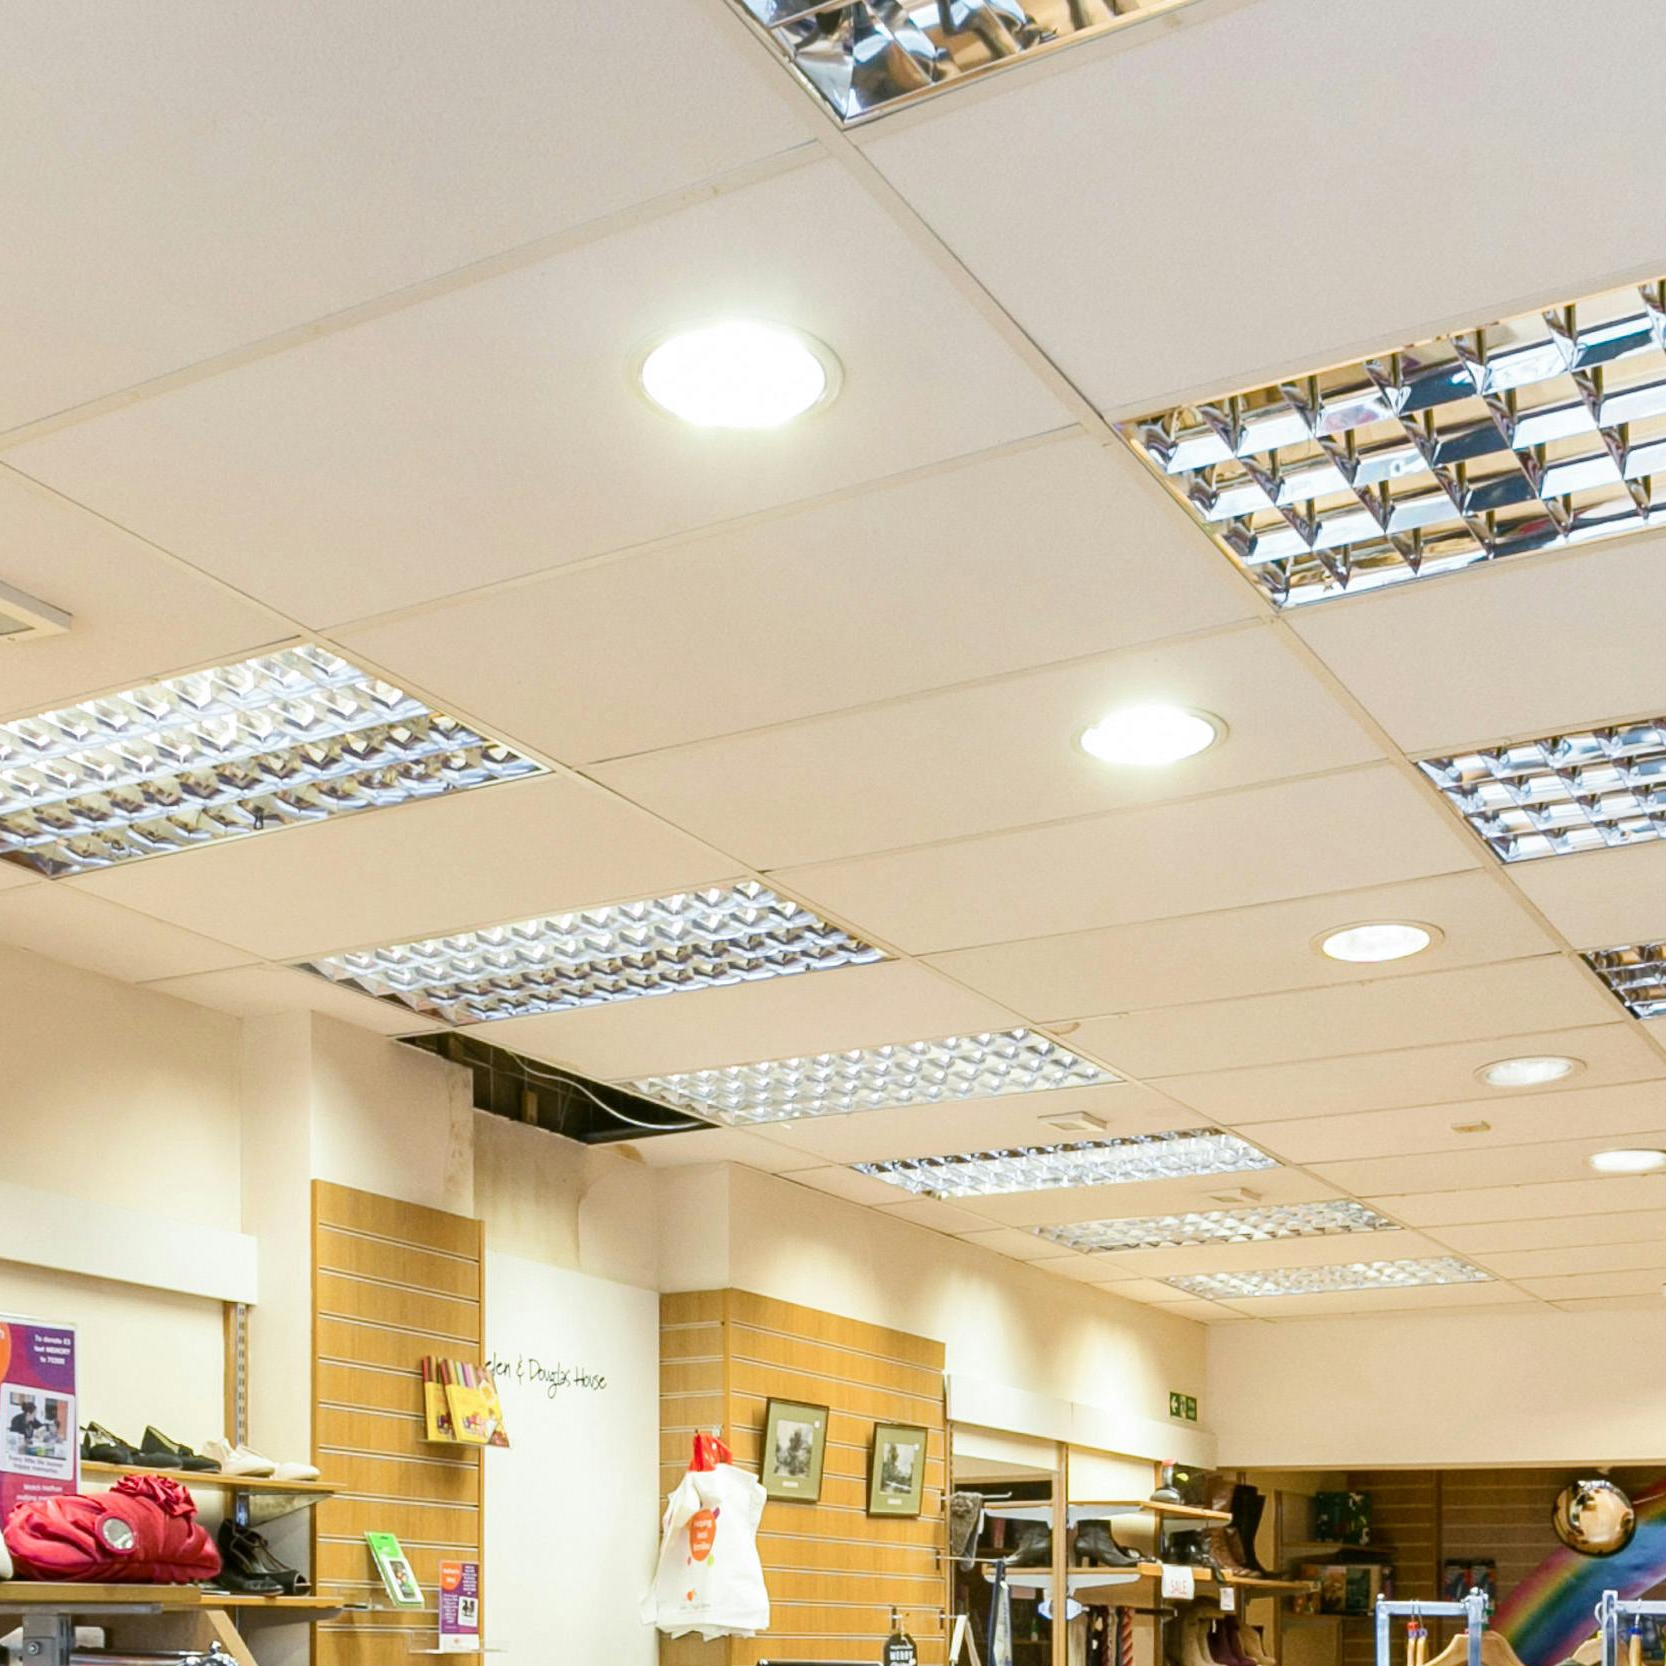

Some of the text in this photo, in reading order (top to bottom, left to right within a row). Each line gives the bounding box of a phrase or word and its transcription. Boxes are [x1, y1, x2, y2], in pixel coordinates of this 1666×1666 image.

[515, 1353, 525, 1385] &
[528, 1358, 571, 1399] Douglas
[573, 1366, 608, 1391] House
